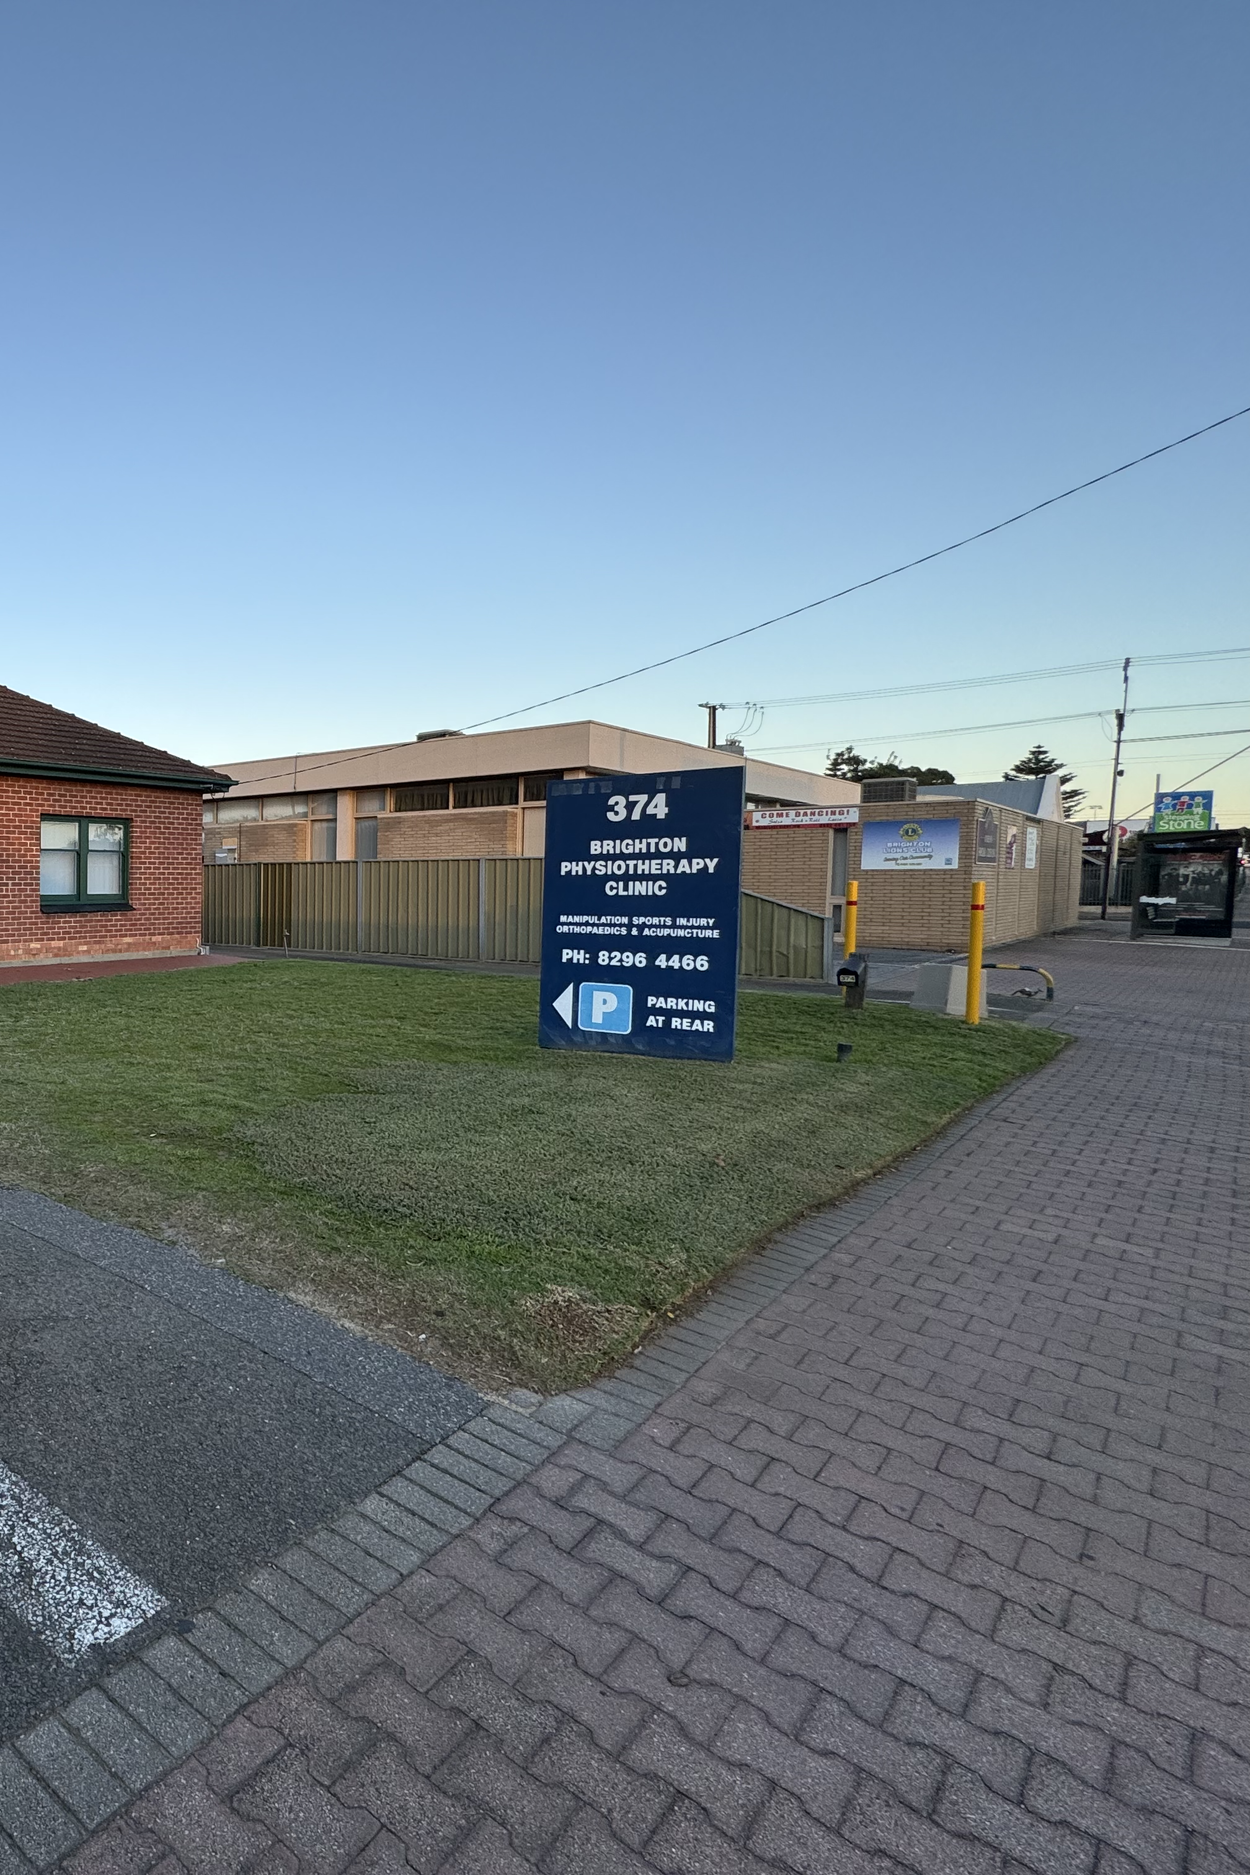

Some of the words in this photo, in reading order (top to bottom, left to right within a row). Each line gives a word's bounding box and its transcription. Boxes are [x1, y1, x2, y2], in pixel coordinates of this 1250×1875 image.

[607, 793, 669, 821] 374
[794, 809, 850, 818] DANCING!
[590, 837, 687, 855] BRIGHTON
[560, 858, 719, 875] PHYSIOTHERAPY
[605, 881, 668, 896] CLINIC
[560, 914, 629, 925] MANIPULATION
[632, 916, 673, 926] SPORTS
[676, 917, 716, 927] INJURY
[556, 925, 628, 936] ORTHOPAEDICS
[631, 927, 639, 936] &
[642, 927, 721, 938] ACUPUNCTURE
[562, 949, 590, 965] PH:
[598, 950, 647, 968] 8296
[655, 953, 709, 971] 4466
[591, 990, 618, 1024] P
[647, 996, 716, 1013] PARKING
[646, 1015, 666, 1028] AT
[671, 1017, 715, 1033] REAR
